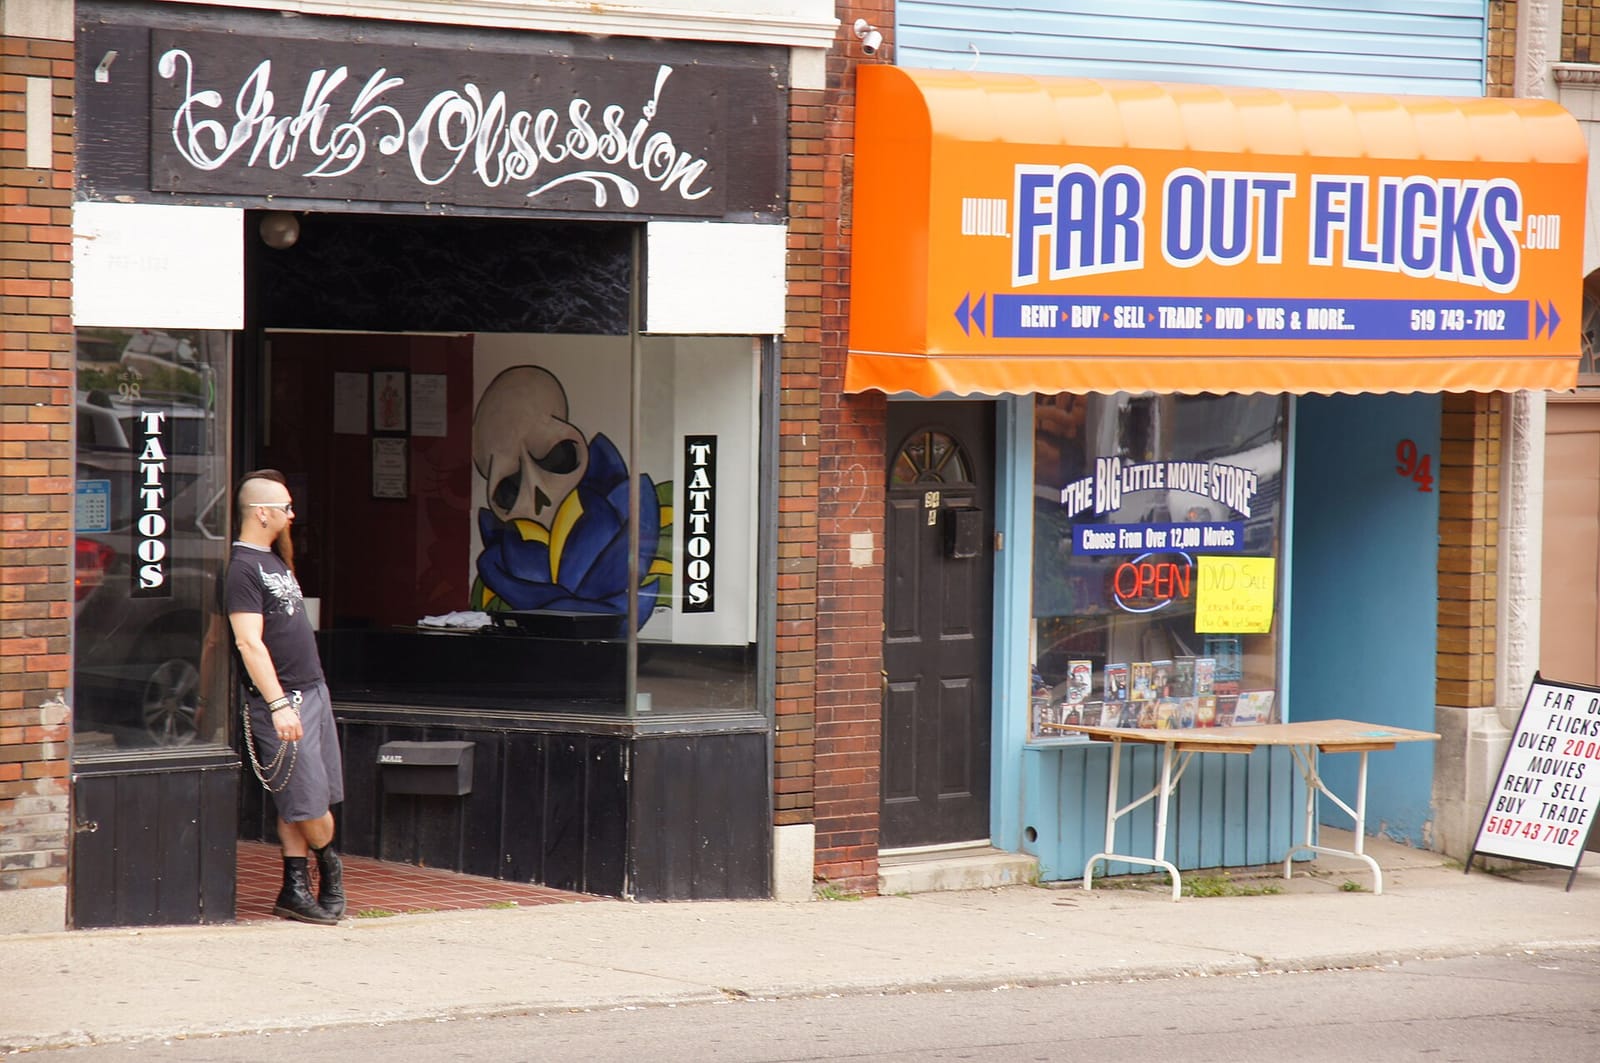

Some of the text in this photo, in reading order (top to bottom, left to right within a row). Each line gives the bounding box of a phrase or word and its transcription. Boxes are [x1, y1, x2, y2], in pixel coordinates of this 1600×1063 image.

[408, 65, 712, 201] Obsession
[1012, 163, 1147, 288] FAR
[1161, 167, 1296, 269] OUT
[1308, 175, 1523, 294] FLICKS
[1021, 305, 1059, 328] RENT
[1071, 305, 1102, 328] BUY
[1113, 305, 1146, 329] SELL
[1158, 306, 1204, 329] TRADE
[1215, 307, 1245, 330] DVD
[1256, 307, 1286, 330] VHS
[1290, 311, 1302, 330] &
[1410, 309, 1436, 331] 519
[118, 382, 142, 402] 98
[1395, 438, 1434, 493] 94
[1095, 456, 1122, 515] BIG
[1122, 462, 1165, 493] LITTLE
[1167, 461, 1210, 498] MOVIE
[137, 410, 168, 590] TATTOOS
[687, 443, 713, 605] TATTOOS
[1082, 526, 1235, 550] Choose From Over 12,000 Movies
[1114, 562, 1191, 599] OPEN
[1543, 691, 1600, 715] FAR O
[1547, 714, 1600, 737] FLICKS
[1517, 732, 1557, 753] OVER
[1527, 755, 1586, 779] MOVIES
[1503, 775, 1587, 803] RENT SELL
[1496, 795, 1589, 826] BUY TRADE
